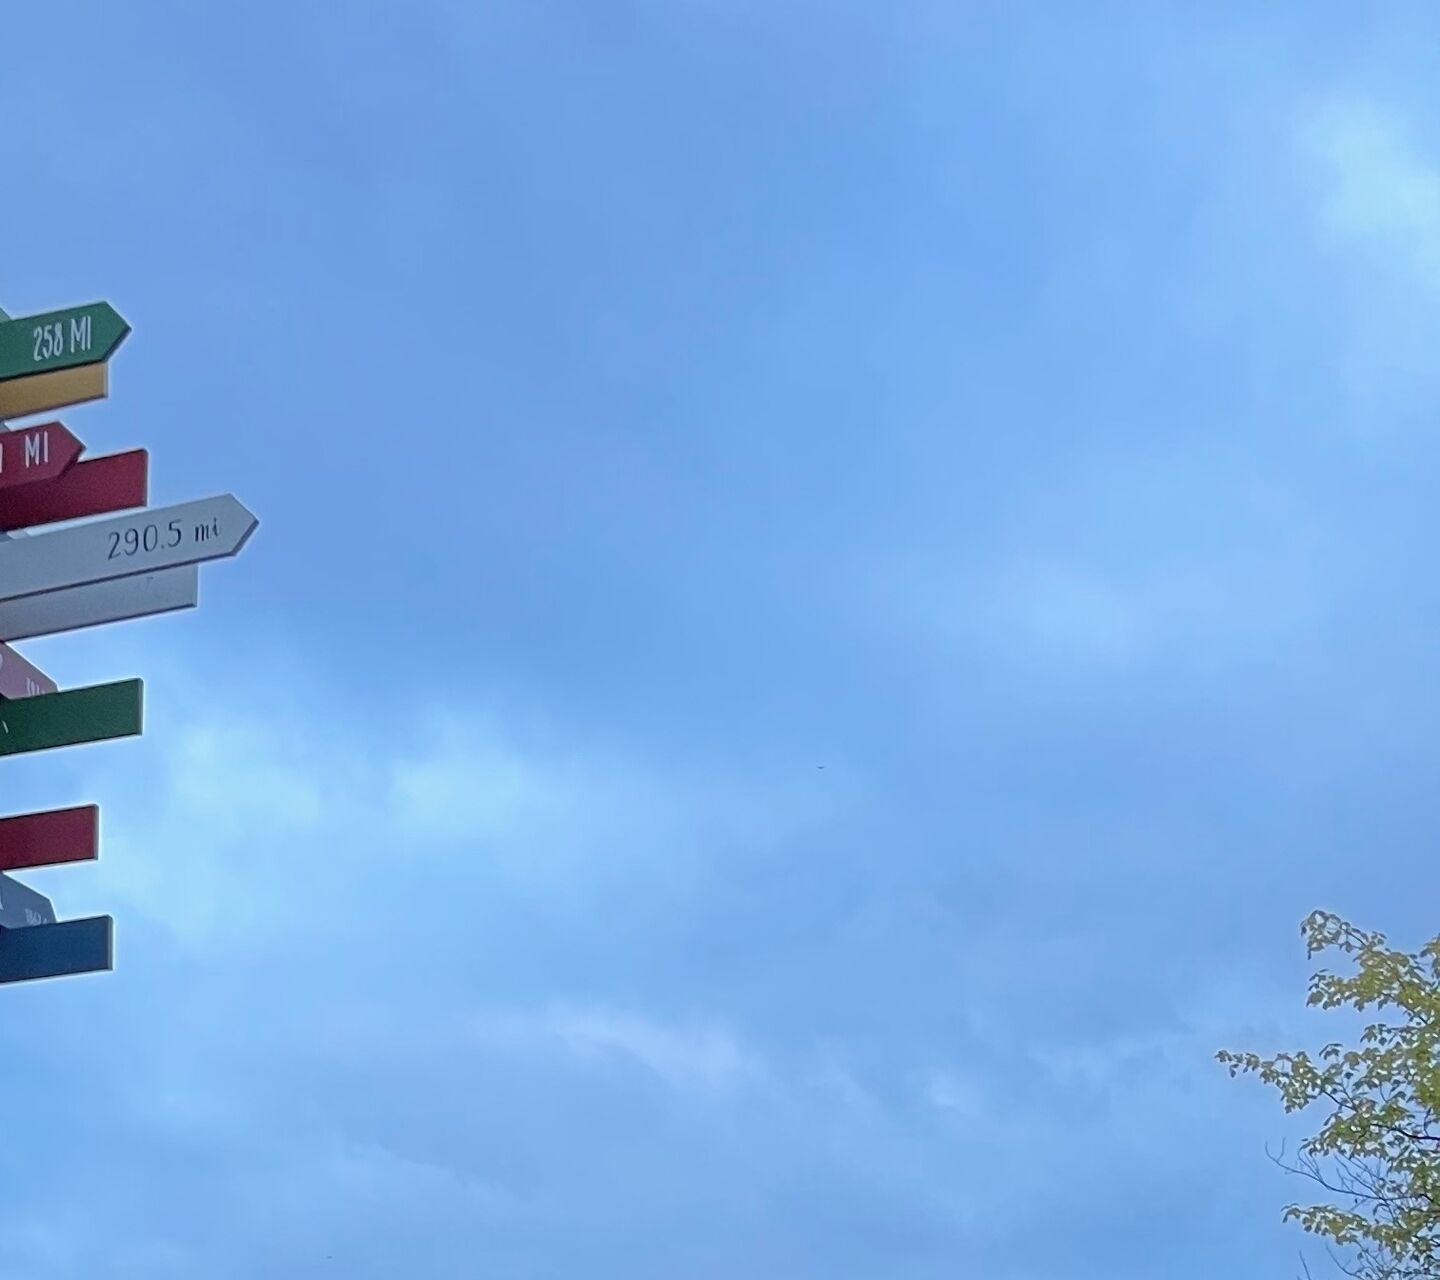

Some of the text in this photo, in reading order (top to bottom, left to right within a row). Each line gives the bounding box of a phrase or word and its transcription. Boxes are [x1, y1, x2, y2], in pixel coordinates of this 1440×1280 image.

[32, 315, 92, 363] 258 MI
[24, 430, 49, 468] MI
[107, 517, 221, 560] 290.5 mi
